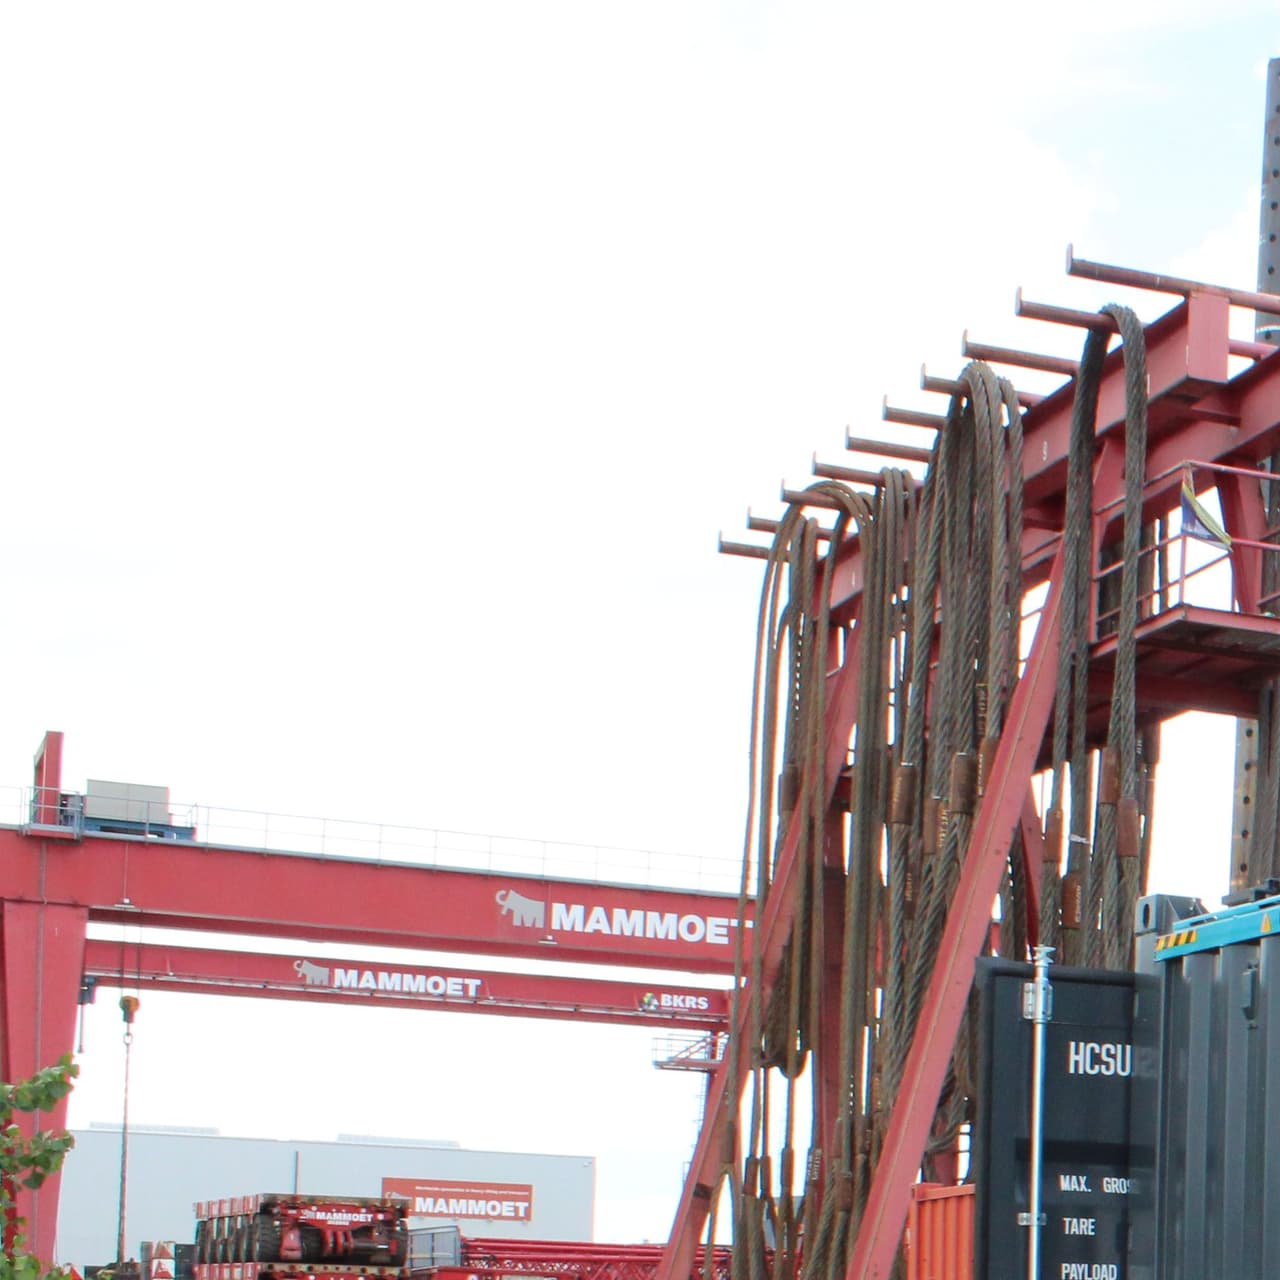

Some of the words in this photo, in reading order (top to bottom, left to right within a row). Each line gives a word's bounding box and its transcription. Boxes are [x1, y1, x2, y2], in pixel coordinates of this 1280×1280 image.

[334, 968, 482, 997] MAMMOET
[660, 993, 709, 1010] BKRS
[1069, 1041, 1132, 1077] HCSU
[1060, 1174, 1092, 1192] MAX.
[415, 1197, 528, 1217] MAMMOET
[316, 1211, 373, 1222] MAMMOET
[1063, 1218, 1096, 1236] TARE
